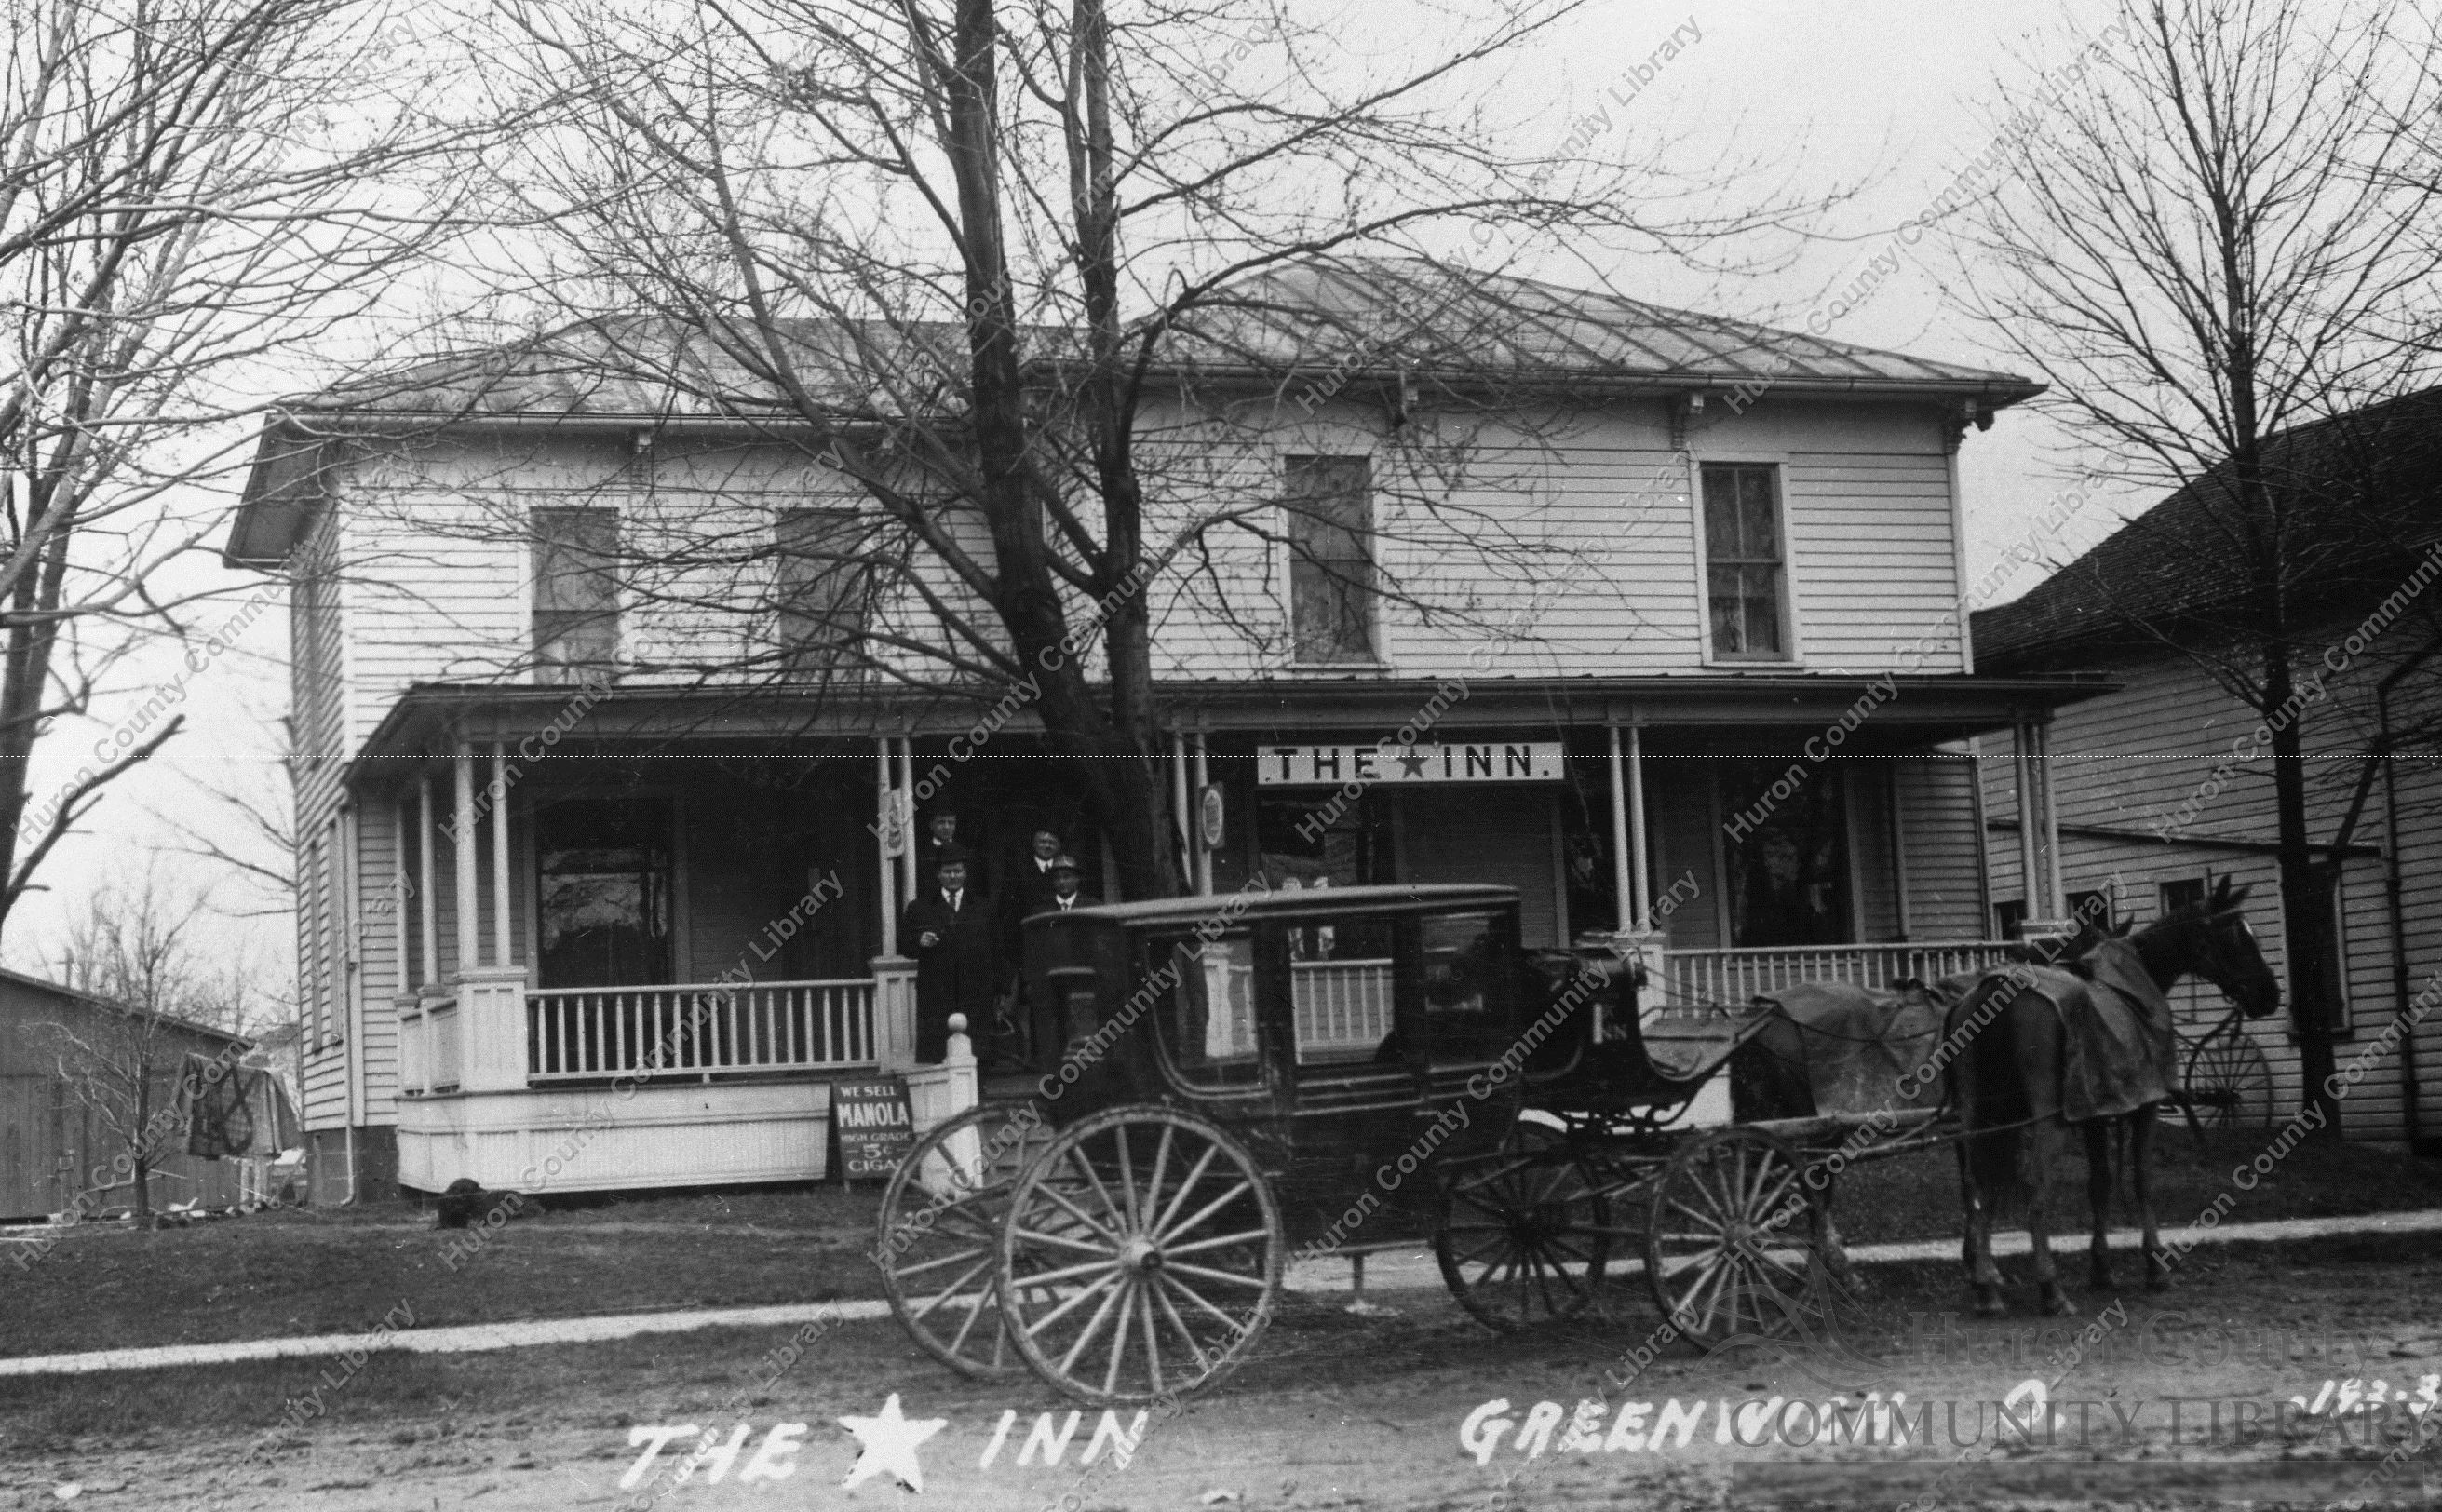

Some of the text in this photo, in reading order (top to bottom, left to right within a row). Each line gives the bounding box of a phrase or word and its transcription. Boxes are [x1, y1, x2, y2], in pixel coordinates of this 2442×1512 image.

[1444, 745, 1551, 778] INN.
[840, 1085, 897, 1098] WE SELL
[837, 1102, 910, 1127] MANOLA
